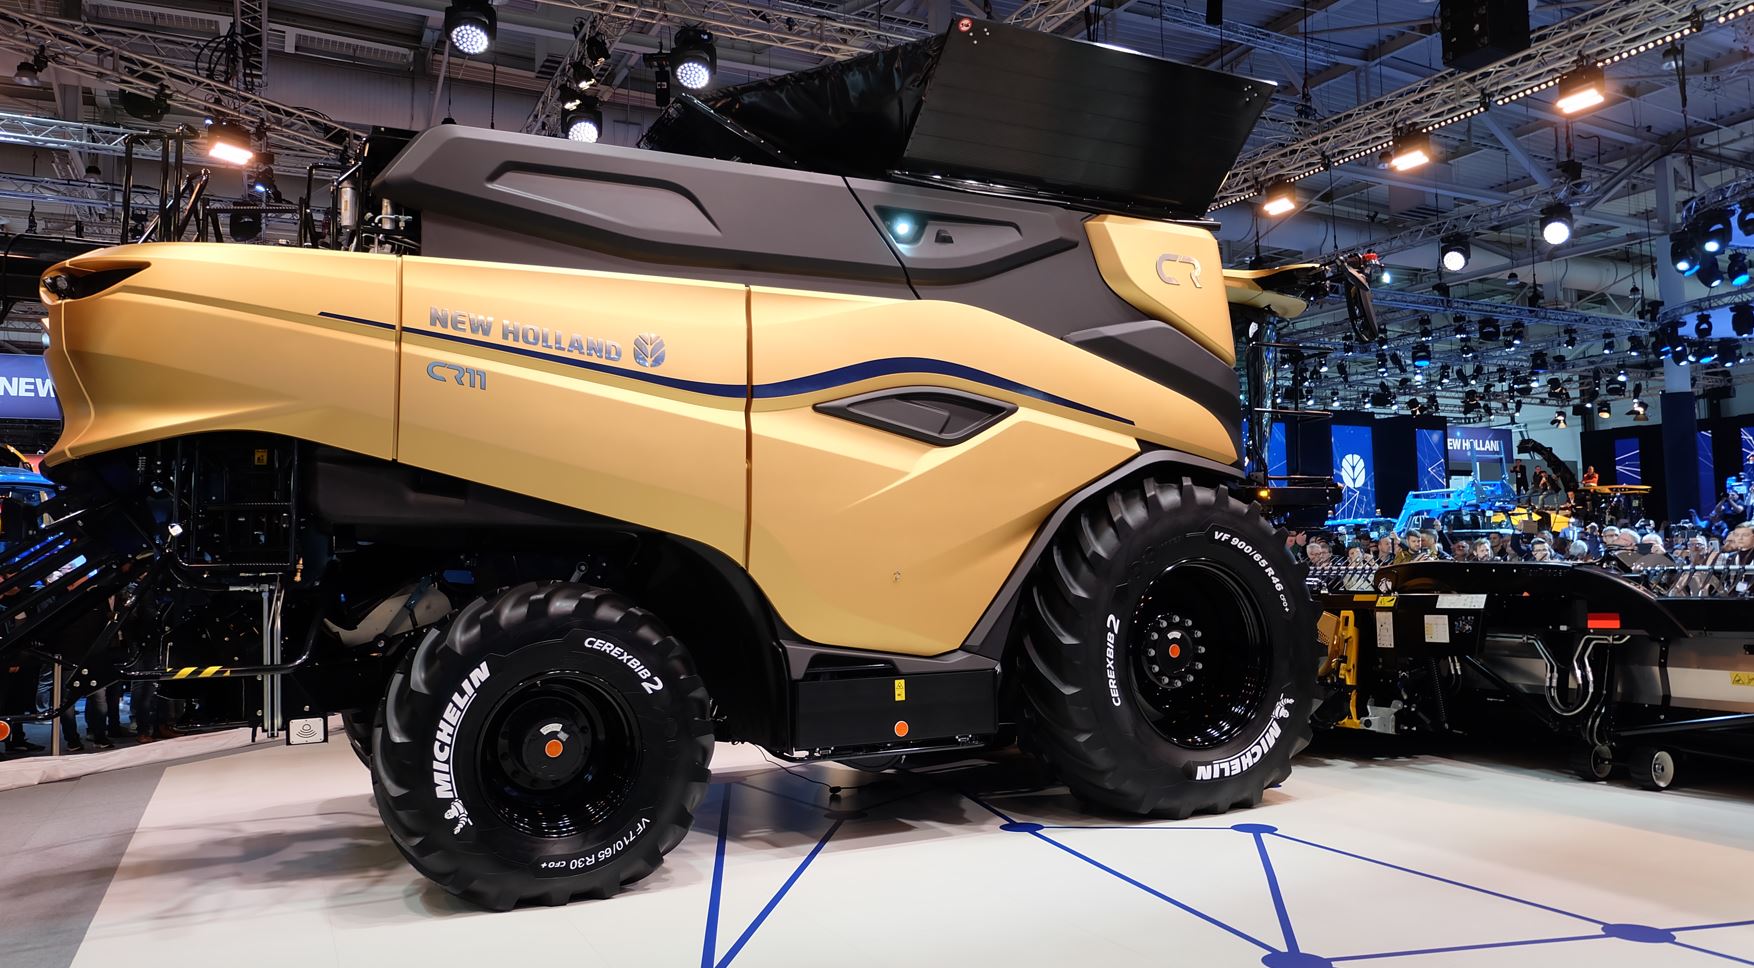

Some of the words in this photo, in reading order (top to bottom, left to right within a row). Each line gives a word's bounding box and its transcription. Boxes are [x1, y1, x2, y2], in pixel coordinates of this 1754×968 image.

[1156, 253, 1202, 289] CR
[429, 305, 494, 337] NEW
[502, 319, 623, 362] HOLLAND
[0, 376, 56, 398] NEW
[426, 361, 487, 391] CR11
[1447, 438, 1461, 450] EW
[1214, 531, 1231, 541] VF
[1230, 537, 1268, 567] 900/65
[1264, 566, 1284, 592] R46
[432, 660, 491, 799] MICHELIN
[1195, 720, 1282, 781] MICHELIN
[569, 854, 595, 870] R30
